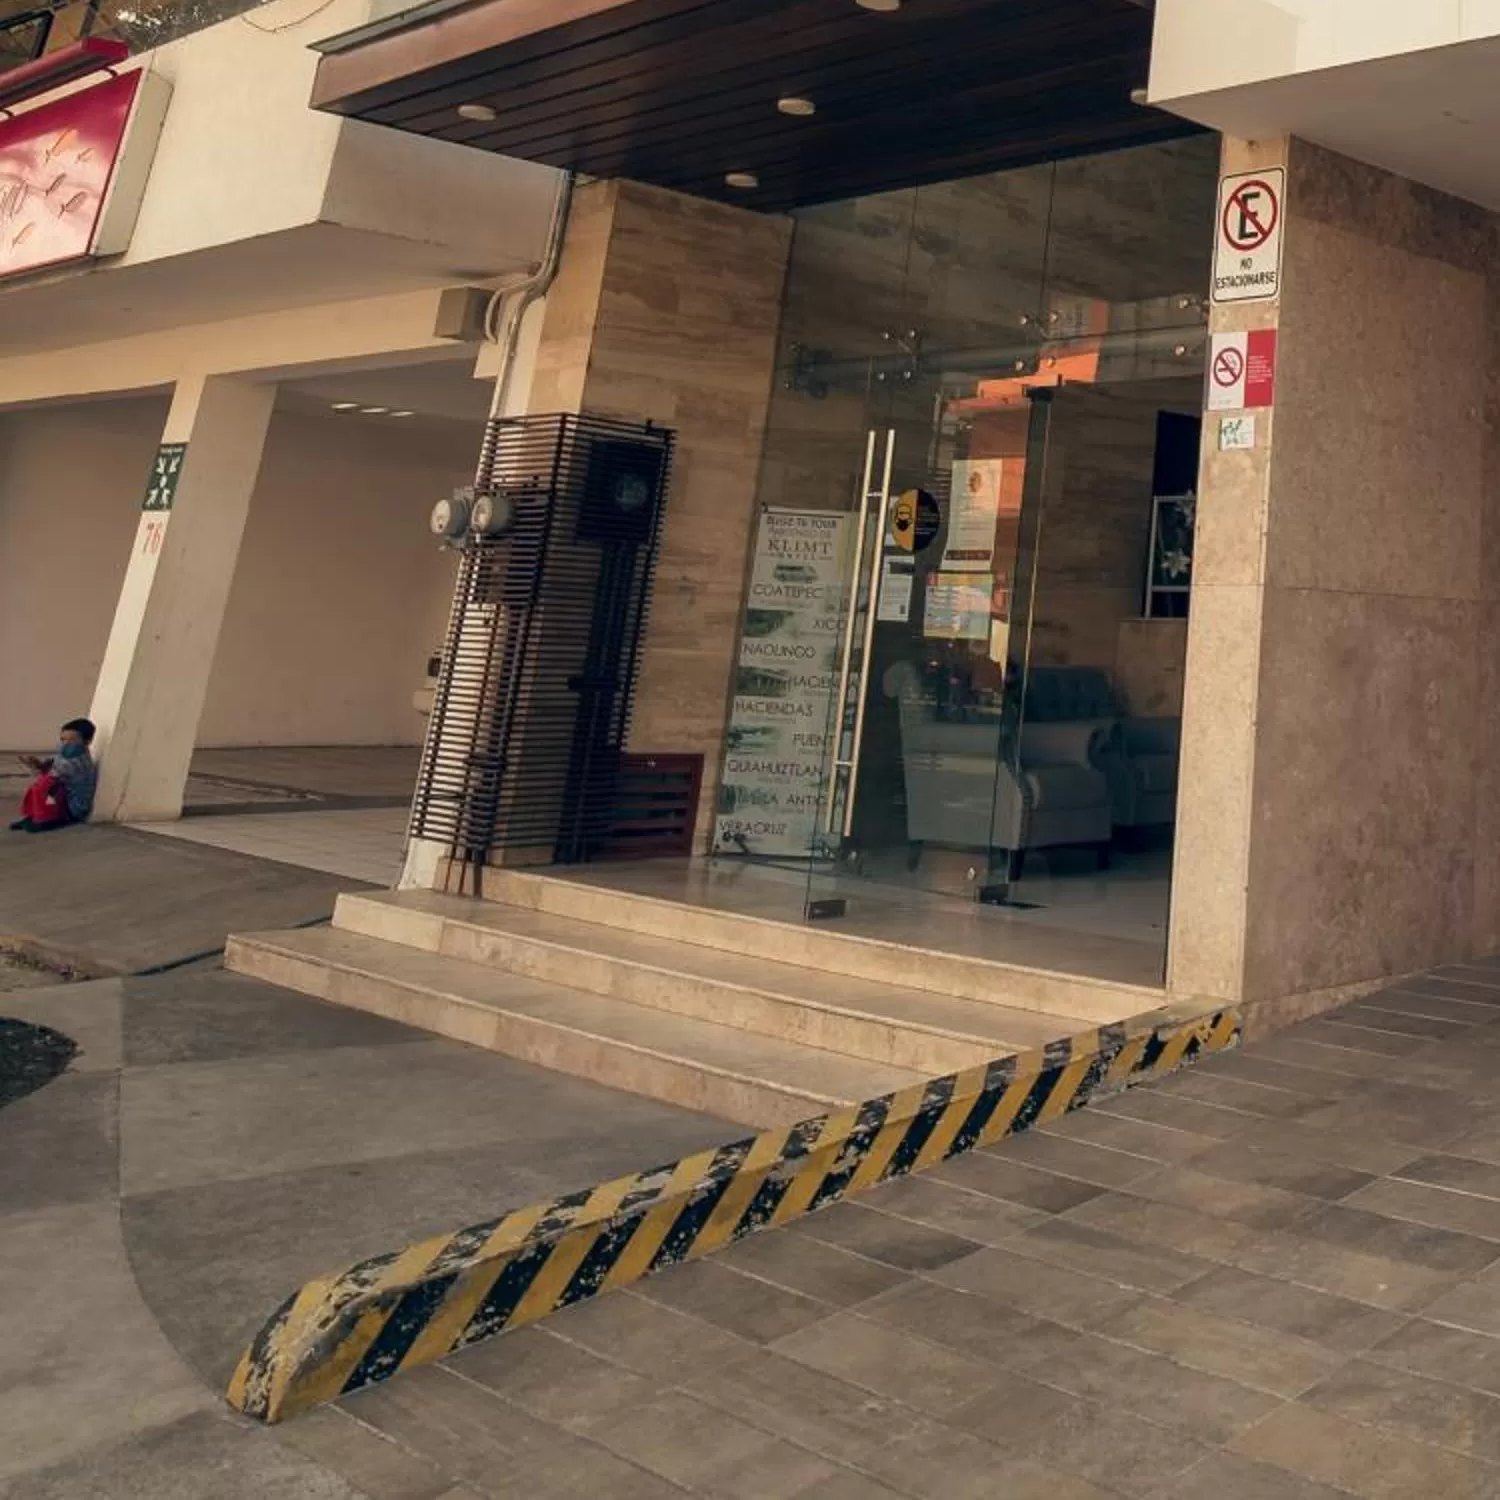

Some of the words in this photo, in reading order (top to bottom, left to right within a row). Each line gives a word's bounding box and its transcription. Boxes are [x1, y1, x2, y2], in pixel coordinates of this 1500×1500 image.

[1240, 257, 1253, 270] NO
[1215, 271, 1276, 289] ESTACIONARSE
[767, 538, 833, 555] KLIMT
[753, 583, 825, 600] COATEPEC
[741, 643, 817, 660] NAOLINCO
[735, 700, 814, 718] HACIENDAS
